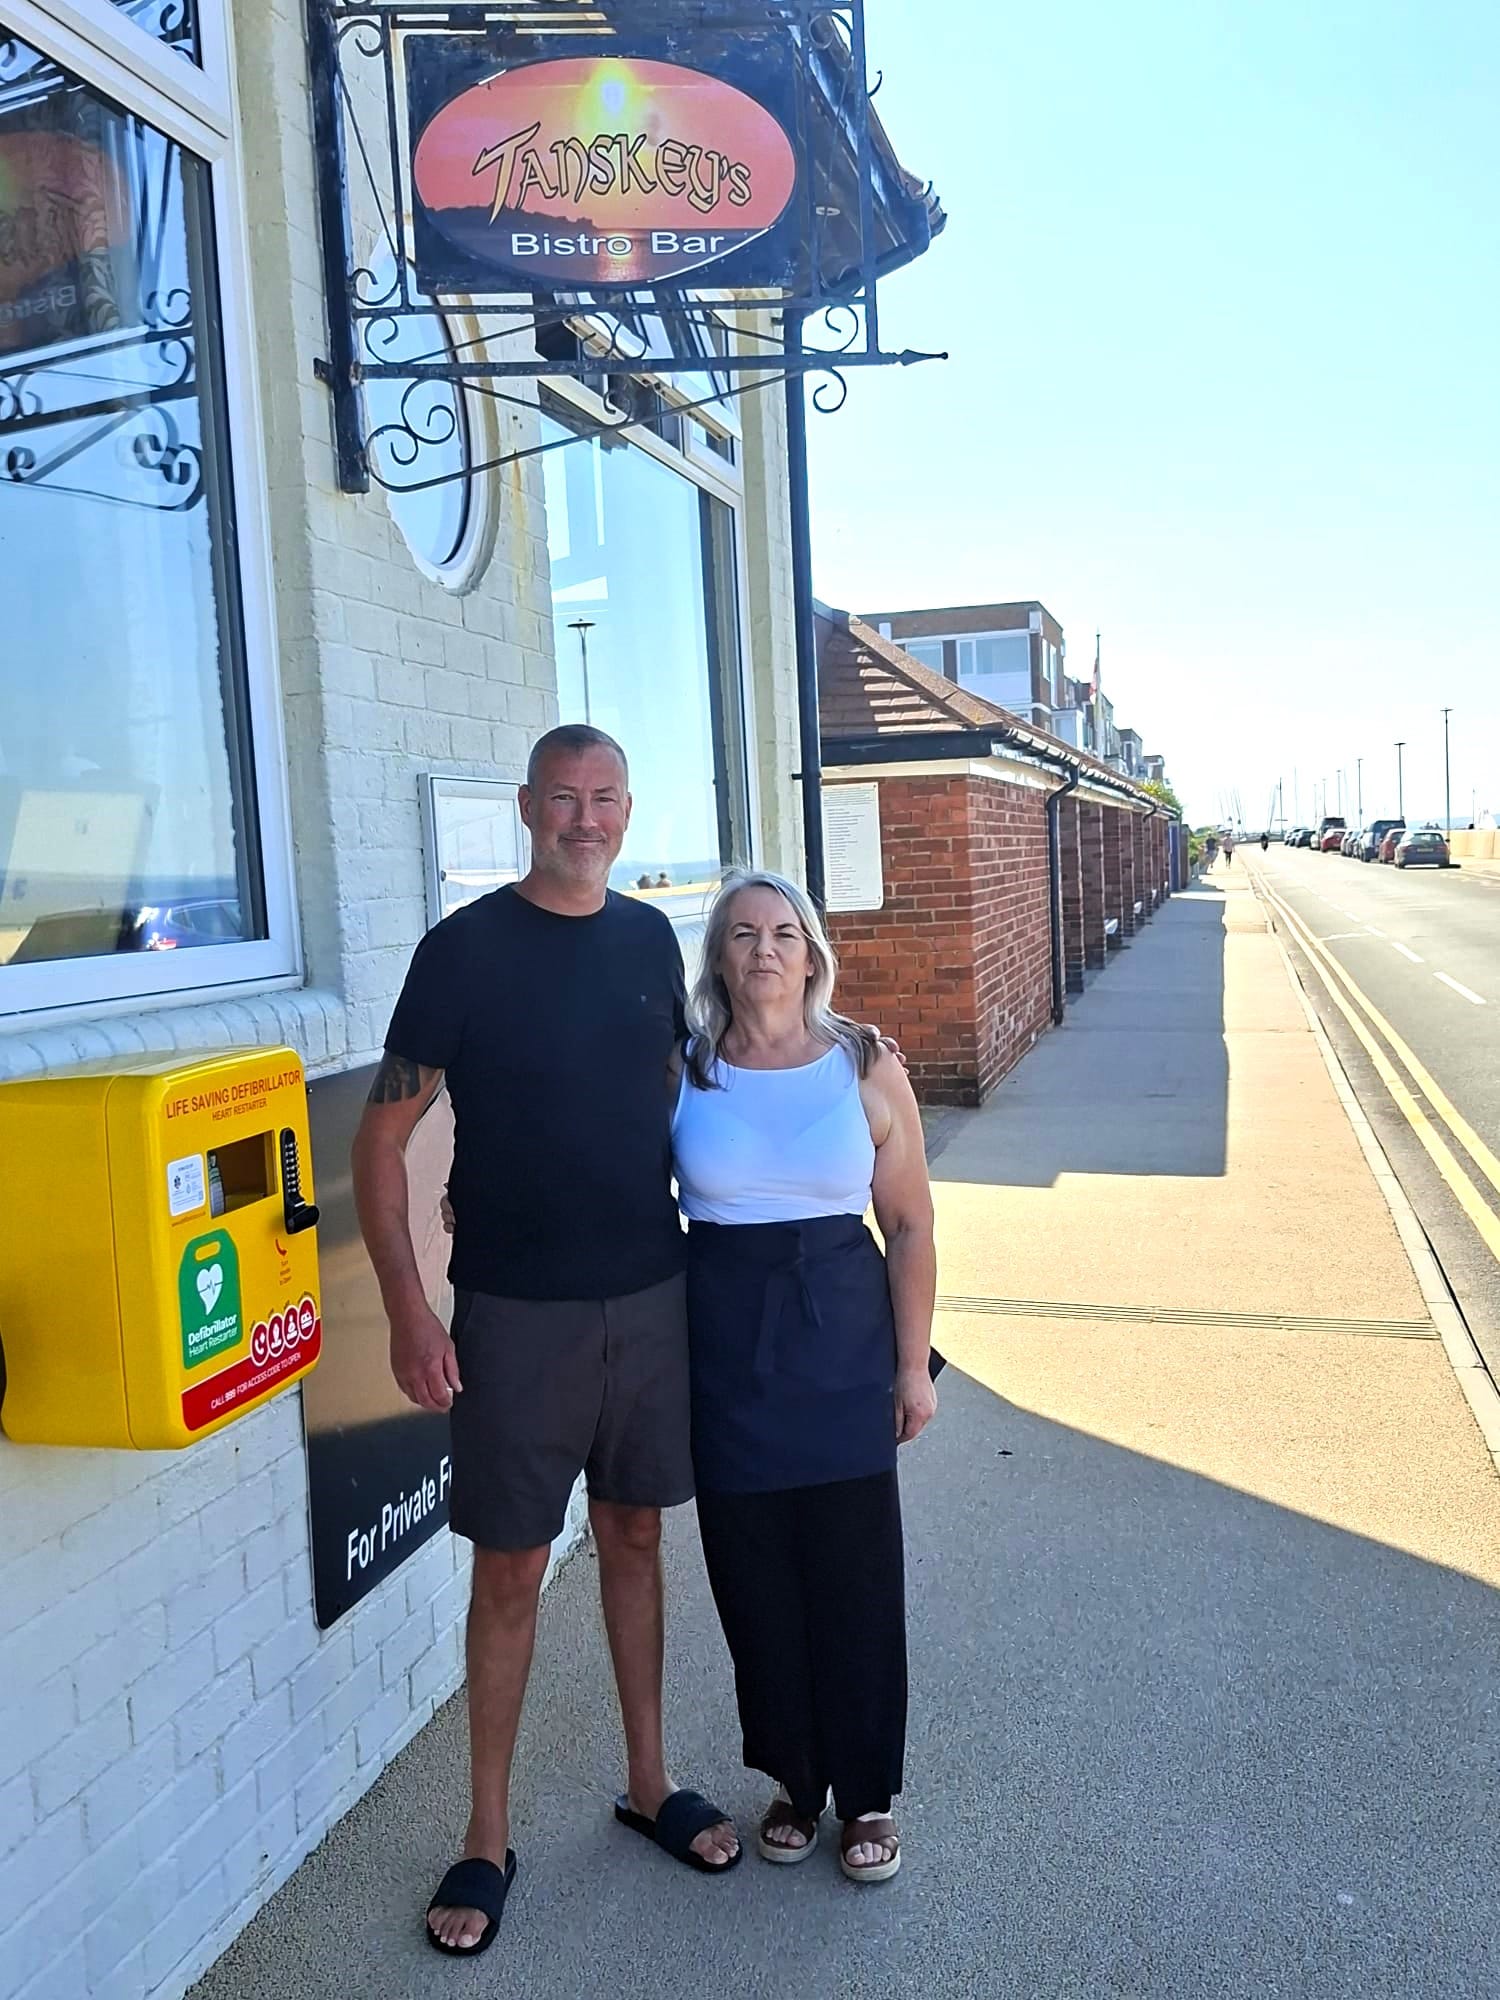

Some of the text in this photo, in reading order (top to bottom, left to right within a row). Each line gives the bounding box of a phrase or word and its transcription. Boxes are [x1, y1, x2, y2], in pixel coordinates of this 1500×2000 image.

[511, 231, 725, 256] Bistro Bar
[166, 1070, 301, 1118] LIFE SAVING DEFIBRILLATOR
[212, 1098, 267, 1120] HEART RESTARTER
[188, 1314, 238, 1346] Defibrillator
[188, 1326, 238, 1358] Heart Restarter
[210, 1396, 225, 1409] CALL
[236, 1381, 248, 1394] FOR
[247, 1370, 268, 1388] ACCESS
[266, 1362, 281, 1378] CODE
[281, 1358, 290, 1369] TO
[287, 1352, 302, 1366] OPEN
[347, 1524, 378, 1581] For
[381, 1475, 436, 1552] Private
